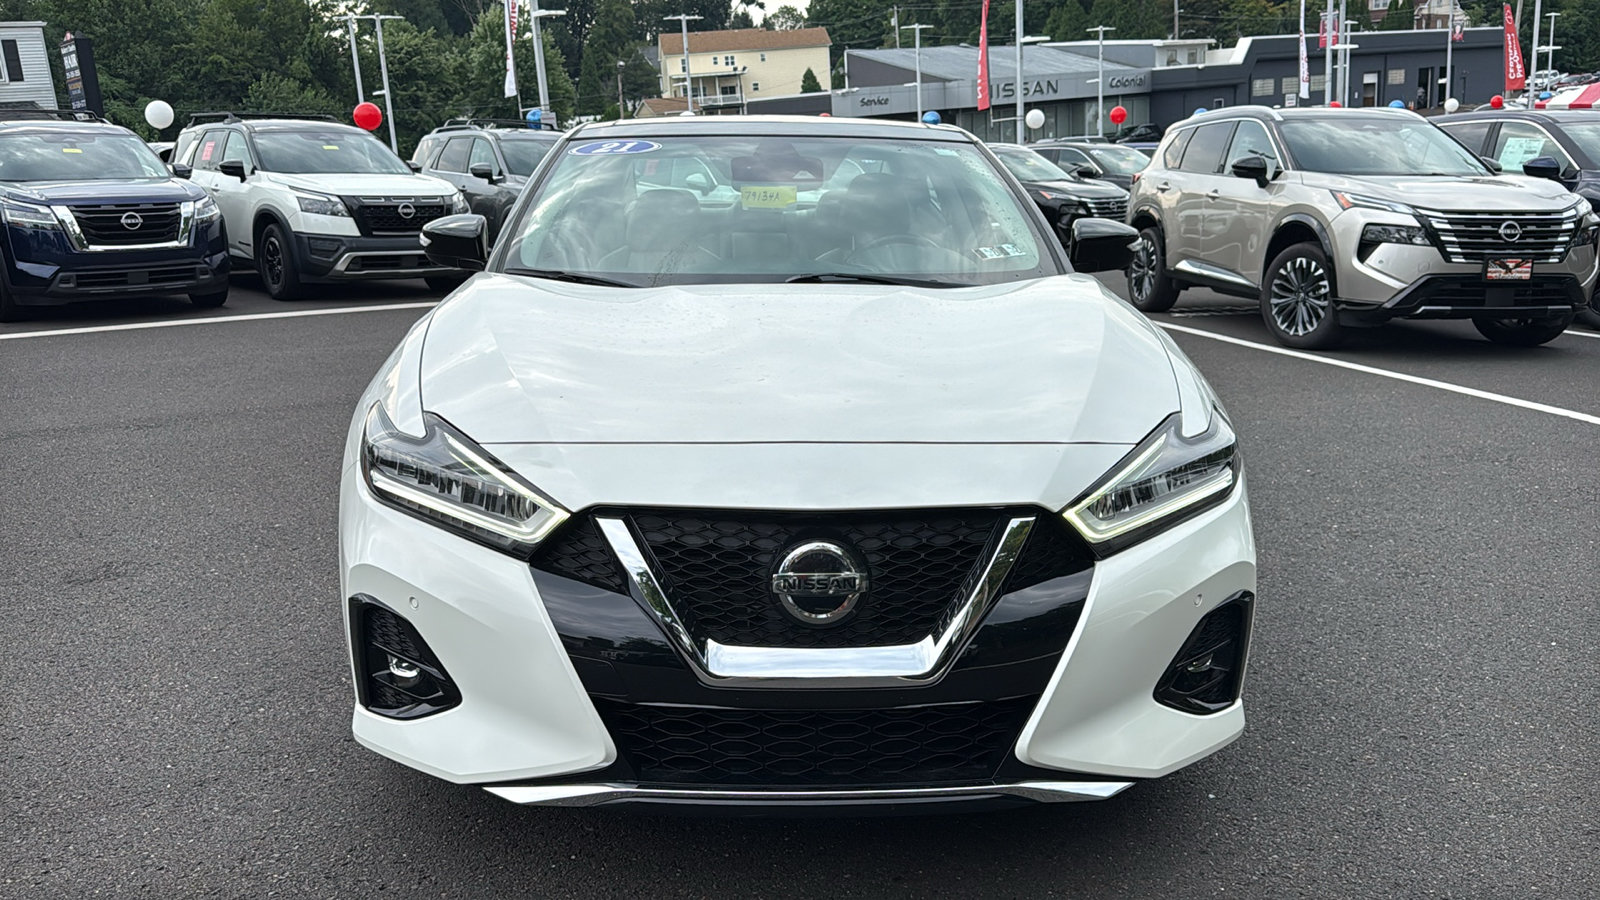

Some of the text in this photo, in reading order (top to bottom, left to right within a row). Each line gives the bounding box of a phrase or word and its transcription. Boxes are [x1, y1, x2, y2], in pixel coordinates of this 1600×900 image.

[1109, 74, 1146, 88] Colonial
[990, 79, 1059, 99] ISSAN
[860, 95, 889, 107] Service
[591, 142, 639, 153] 21
[782, 577, 857, 590] NISSAN
